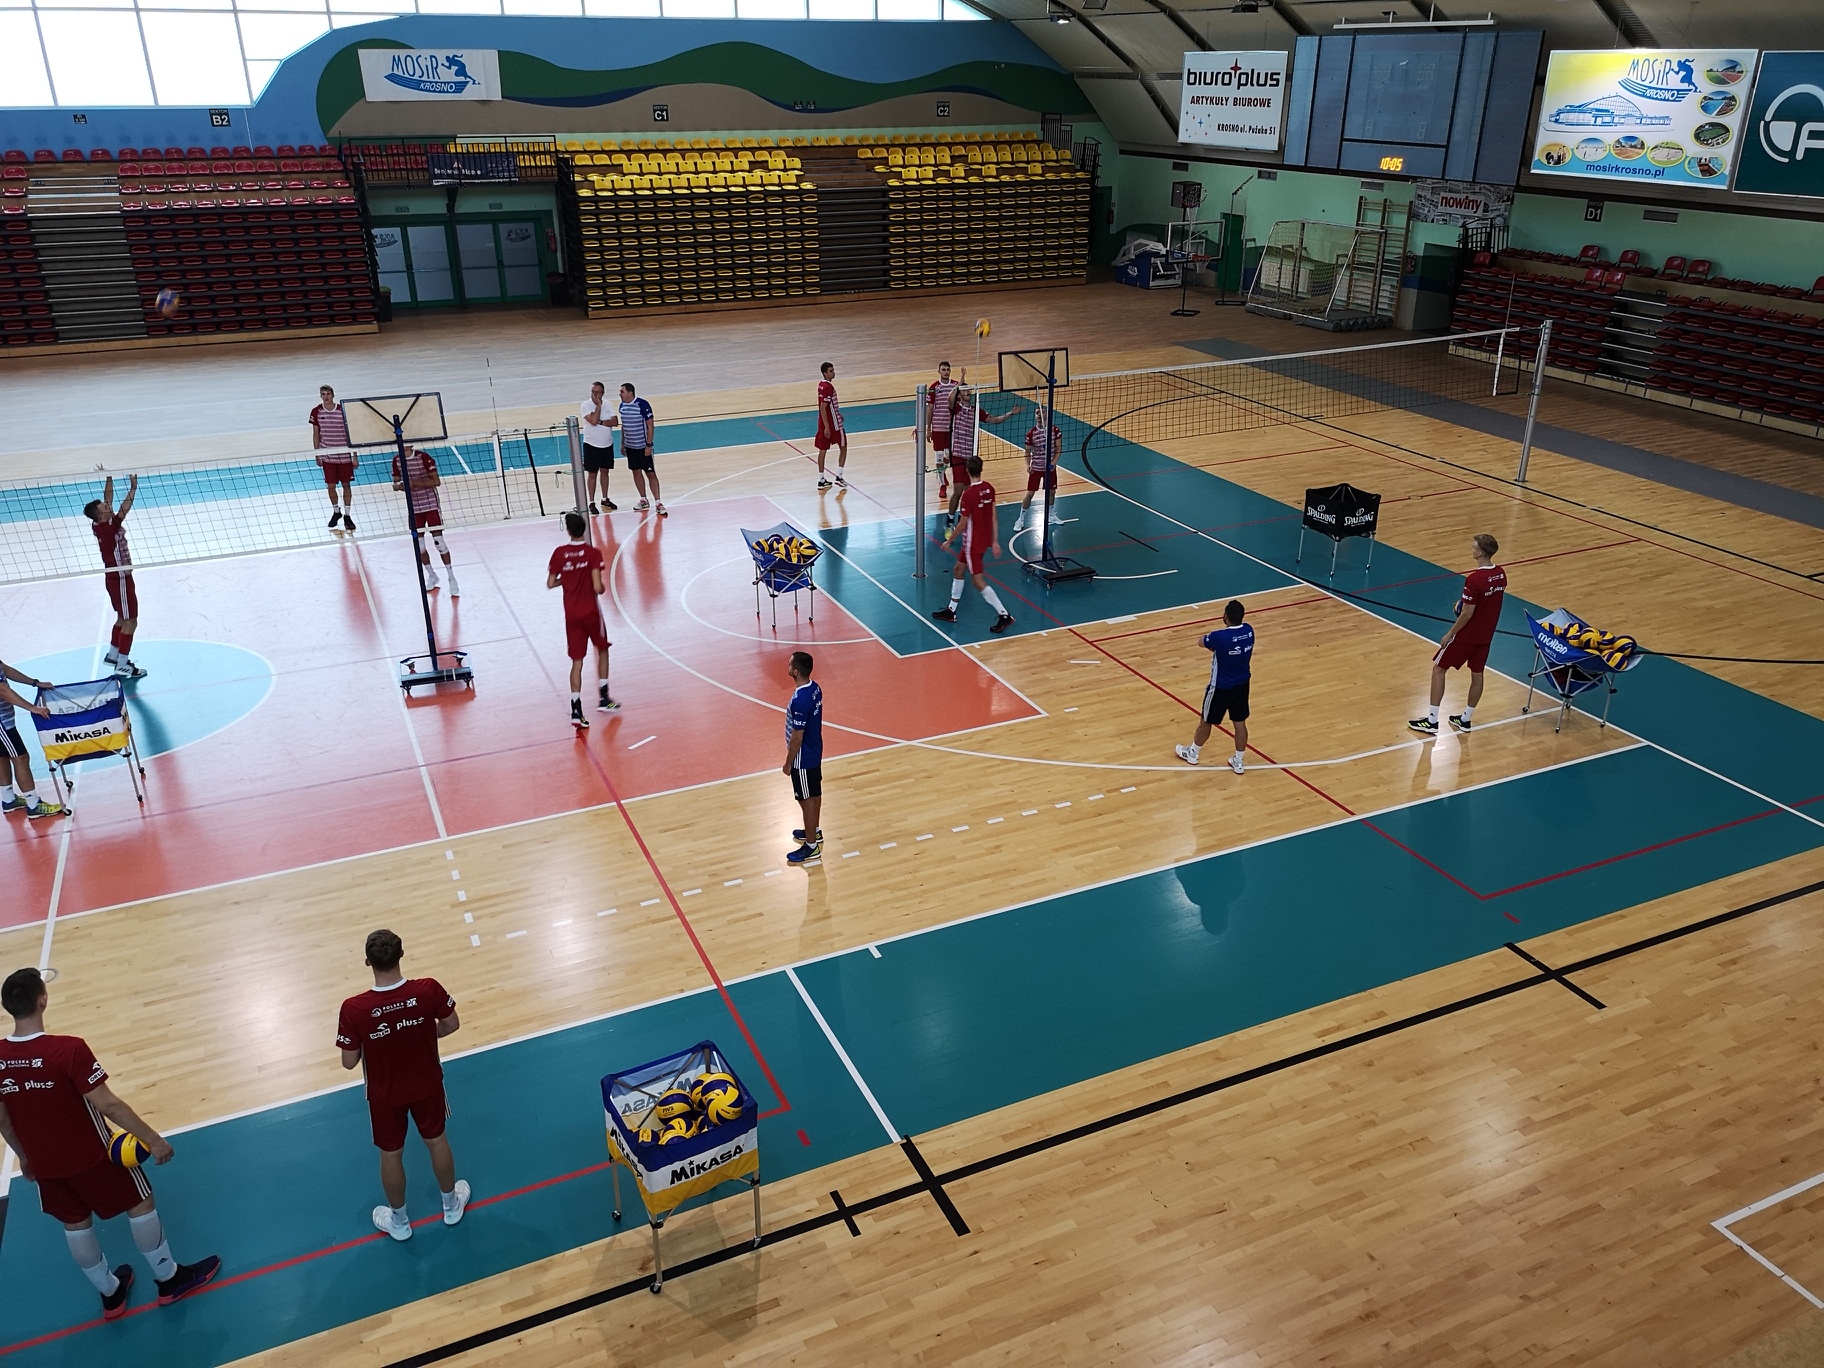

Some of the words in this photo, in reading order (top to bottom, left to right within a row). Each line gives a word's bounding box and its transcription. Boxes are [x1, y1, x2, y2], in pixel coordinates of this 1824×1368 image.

[419, 82, 456, 93] KROSNO
[1644, 88, 1678, 100] KROSNO
[1190, 95, 1230, 107] ARTYKUŁY
[1232, 97, 1272, 108] BIUROWE
[654, 111, 667, 120] C1
[937, 107, 949, 116] C2
[212, 115, 229, 126] B2
[1217, 123, 1240, 133] KROSNO
[1268, 126, 1276, 136] 51
[1379, 156, 1404, 171] 10:05
[1586, 163, 1666, 179] mosirkrosno.pl
[1440, 195, 1482, 214] nowiny
[1586, 208, 1601, 220] D1
[1307, 506, 1336, 525] SPALDING
[1537, 632, 1568, 655] molten
[25, 1080, 46, 1090] plus
